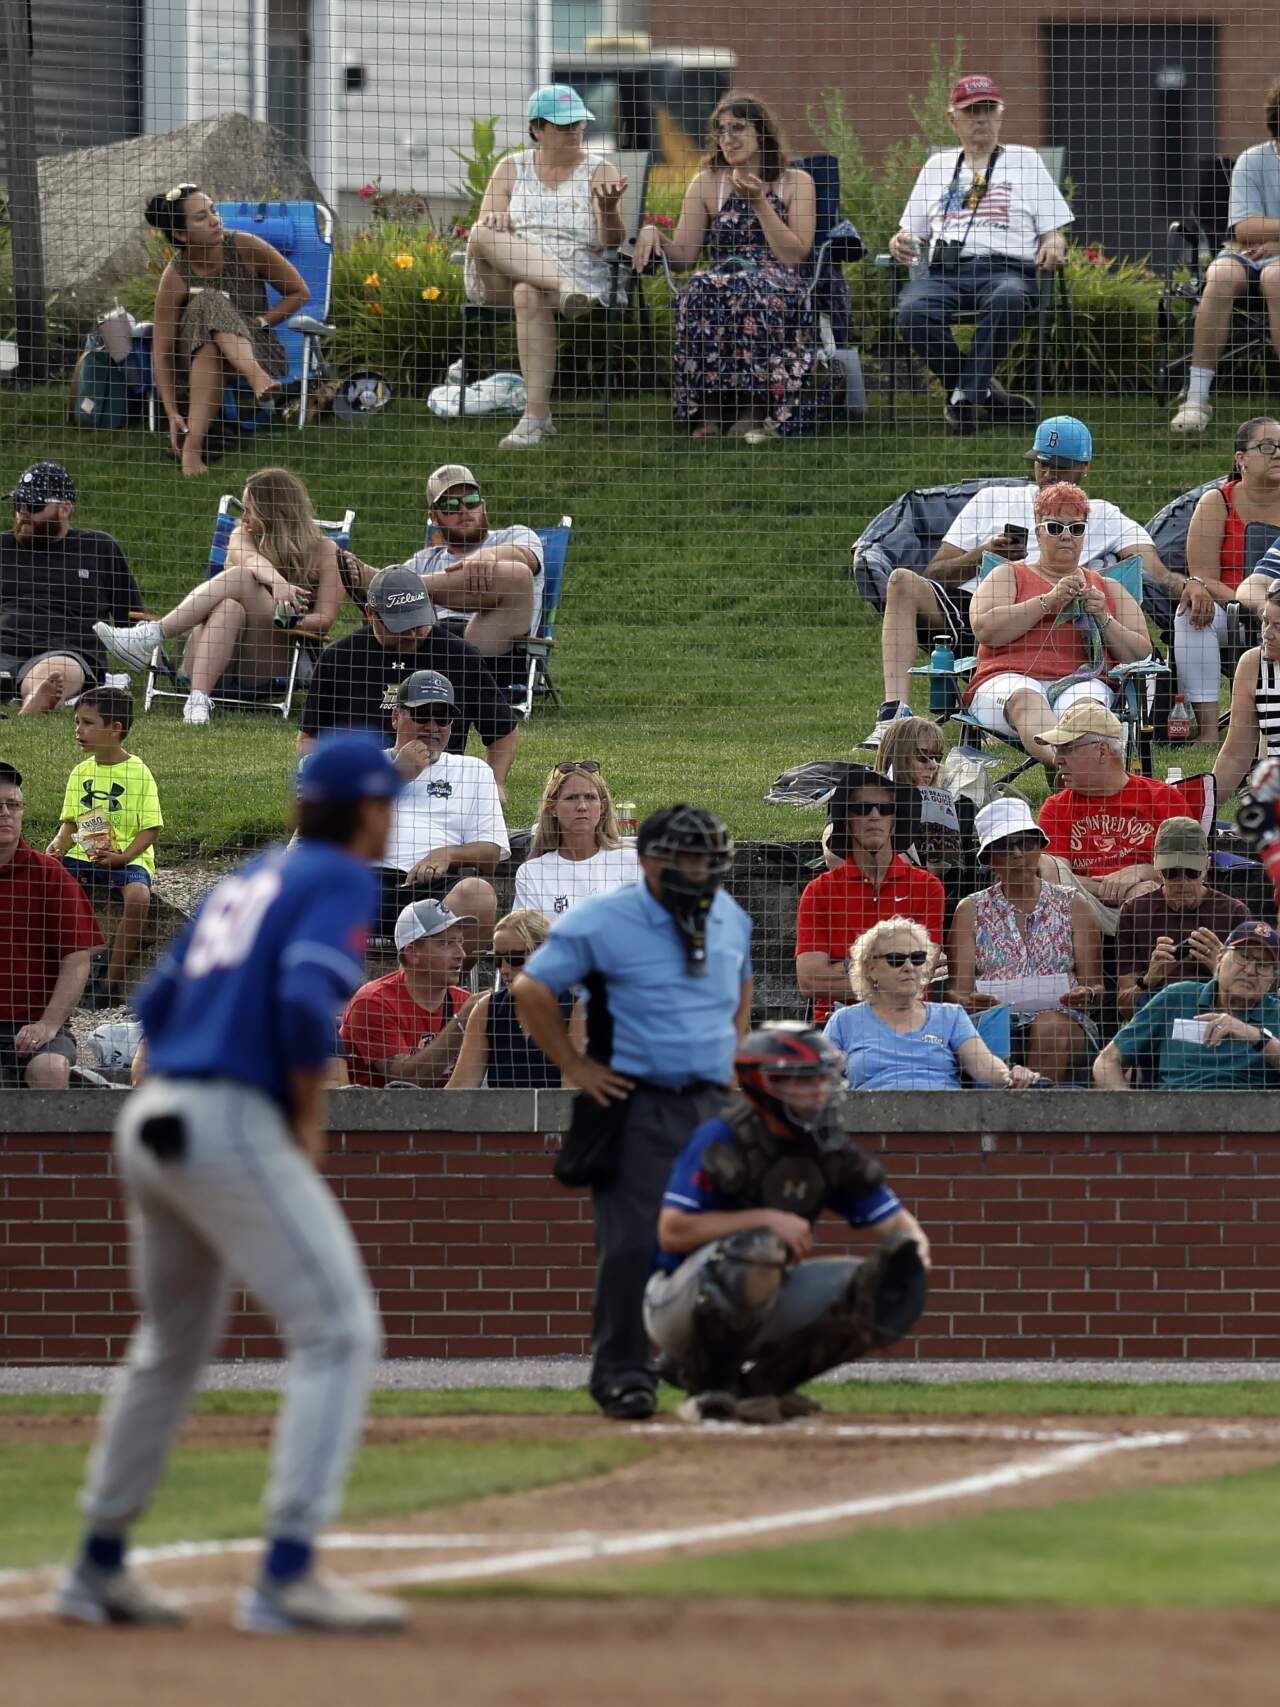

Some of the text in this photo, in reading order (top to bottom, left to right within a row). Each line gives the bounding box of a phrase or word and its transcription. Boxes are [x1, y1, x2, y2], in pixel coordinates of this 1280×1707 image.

[1047, 430, 1059, 449] B
[386, 592, 425, 608] Titleist
[554, 899, 568, 914] GH
